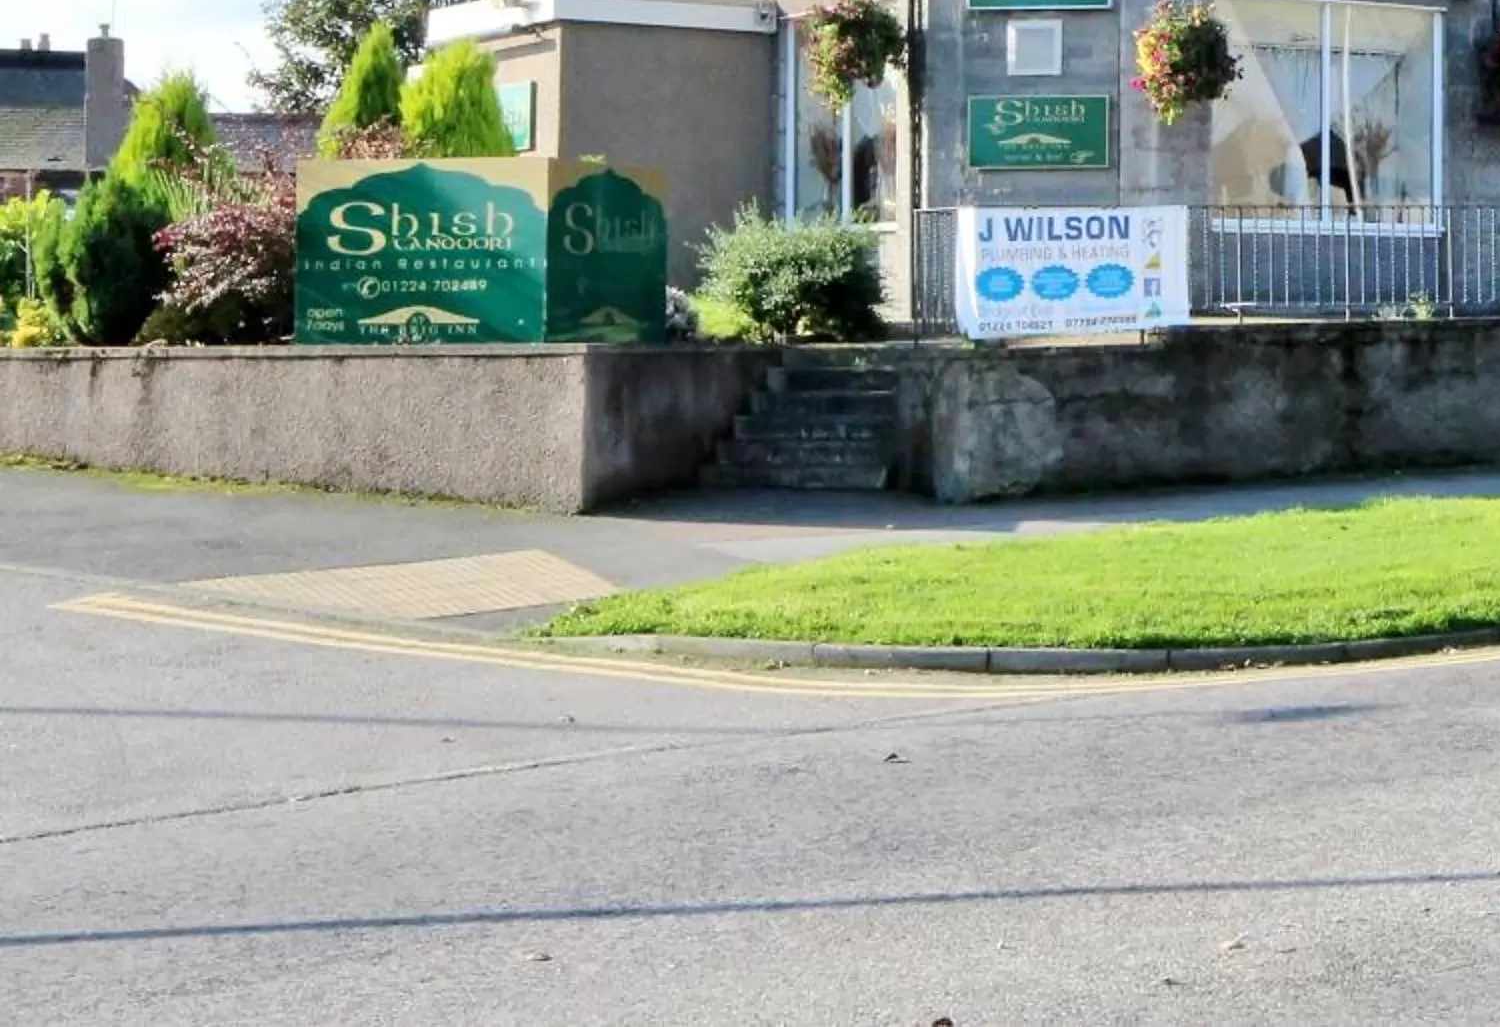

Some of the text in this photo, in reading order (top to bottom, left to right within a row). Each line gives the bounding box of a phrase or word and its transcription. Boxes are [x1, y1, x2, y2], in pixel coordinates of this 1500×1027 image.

[993, 99, 1085, 125] Shish
[327, 200, 514, 256] Shish
[978, 215, 1130, 243] J WILSON
[980, 246, 1053, 262] PLUMBING
[1072, 243, 1130, 260] HEATING
[303, 257, 537, 272] Indian Restaurant
[307, 308, 344, 322] open
